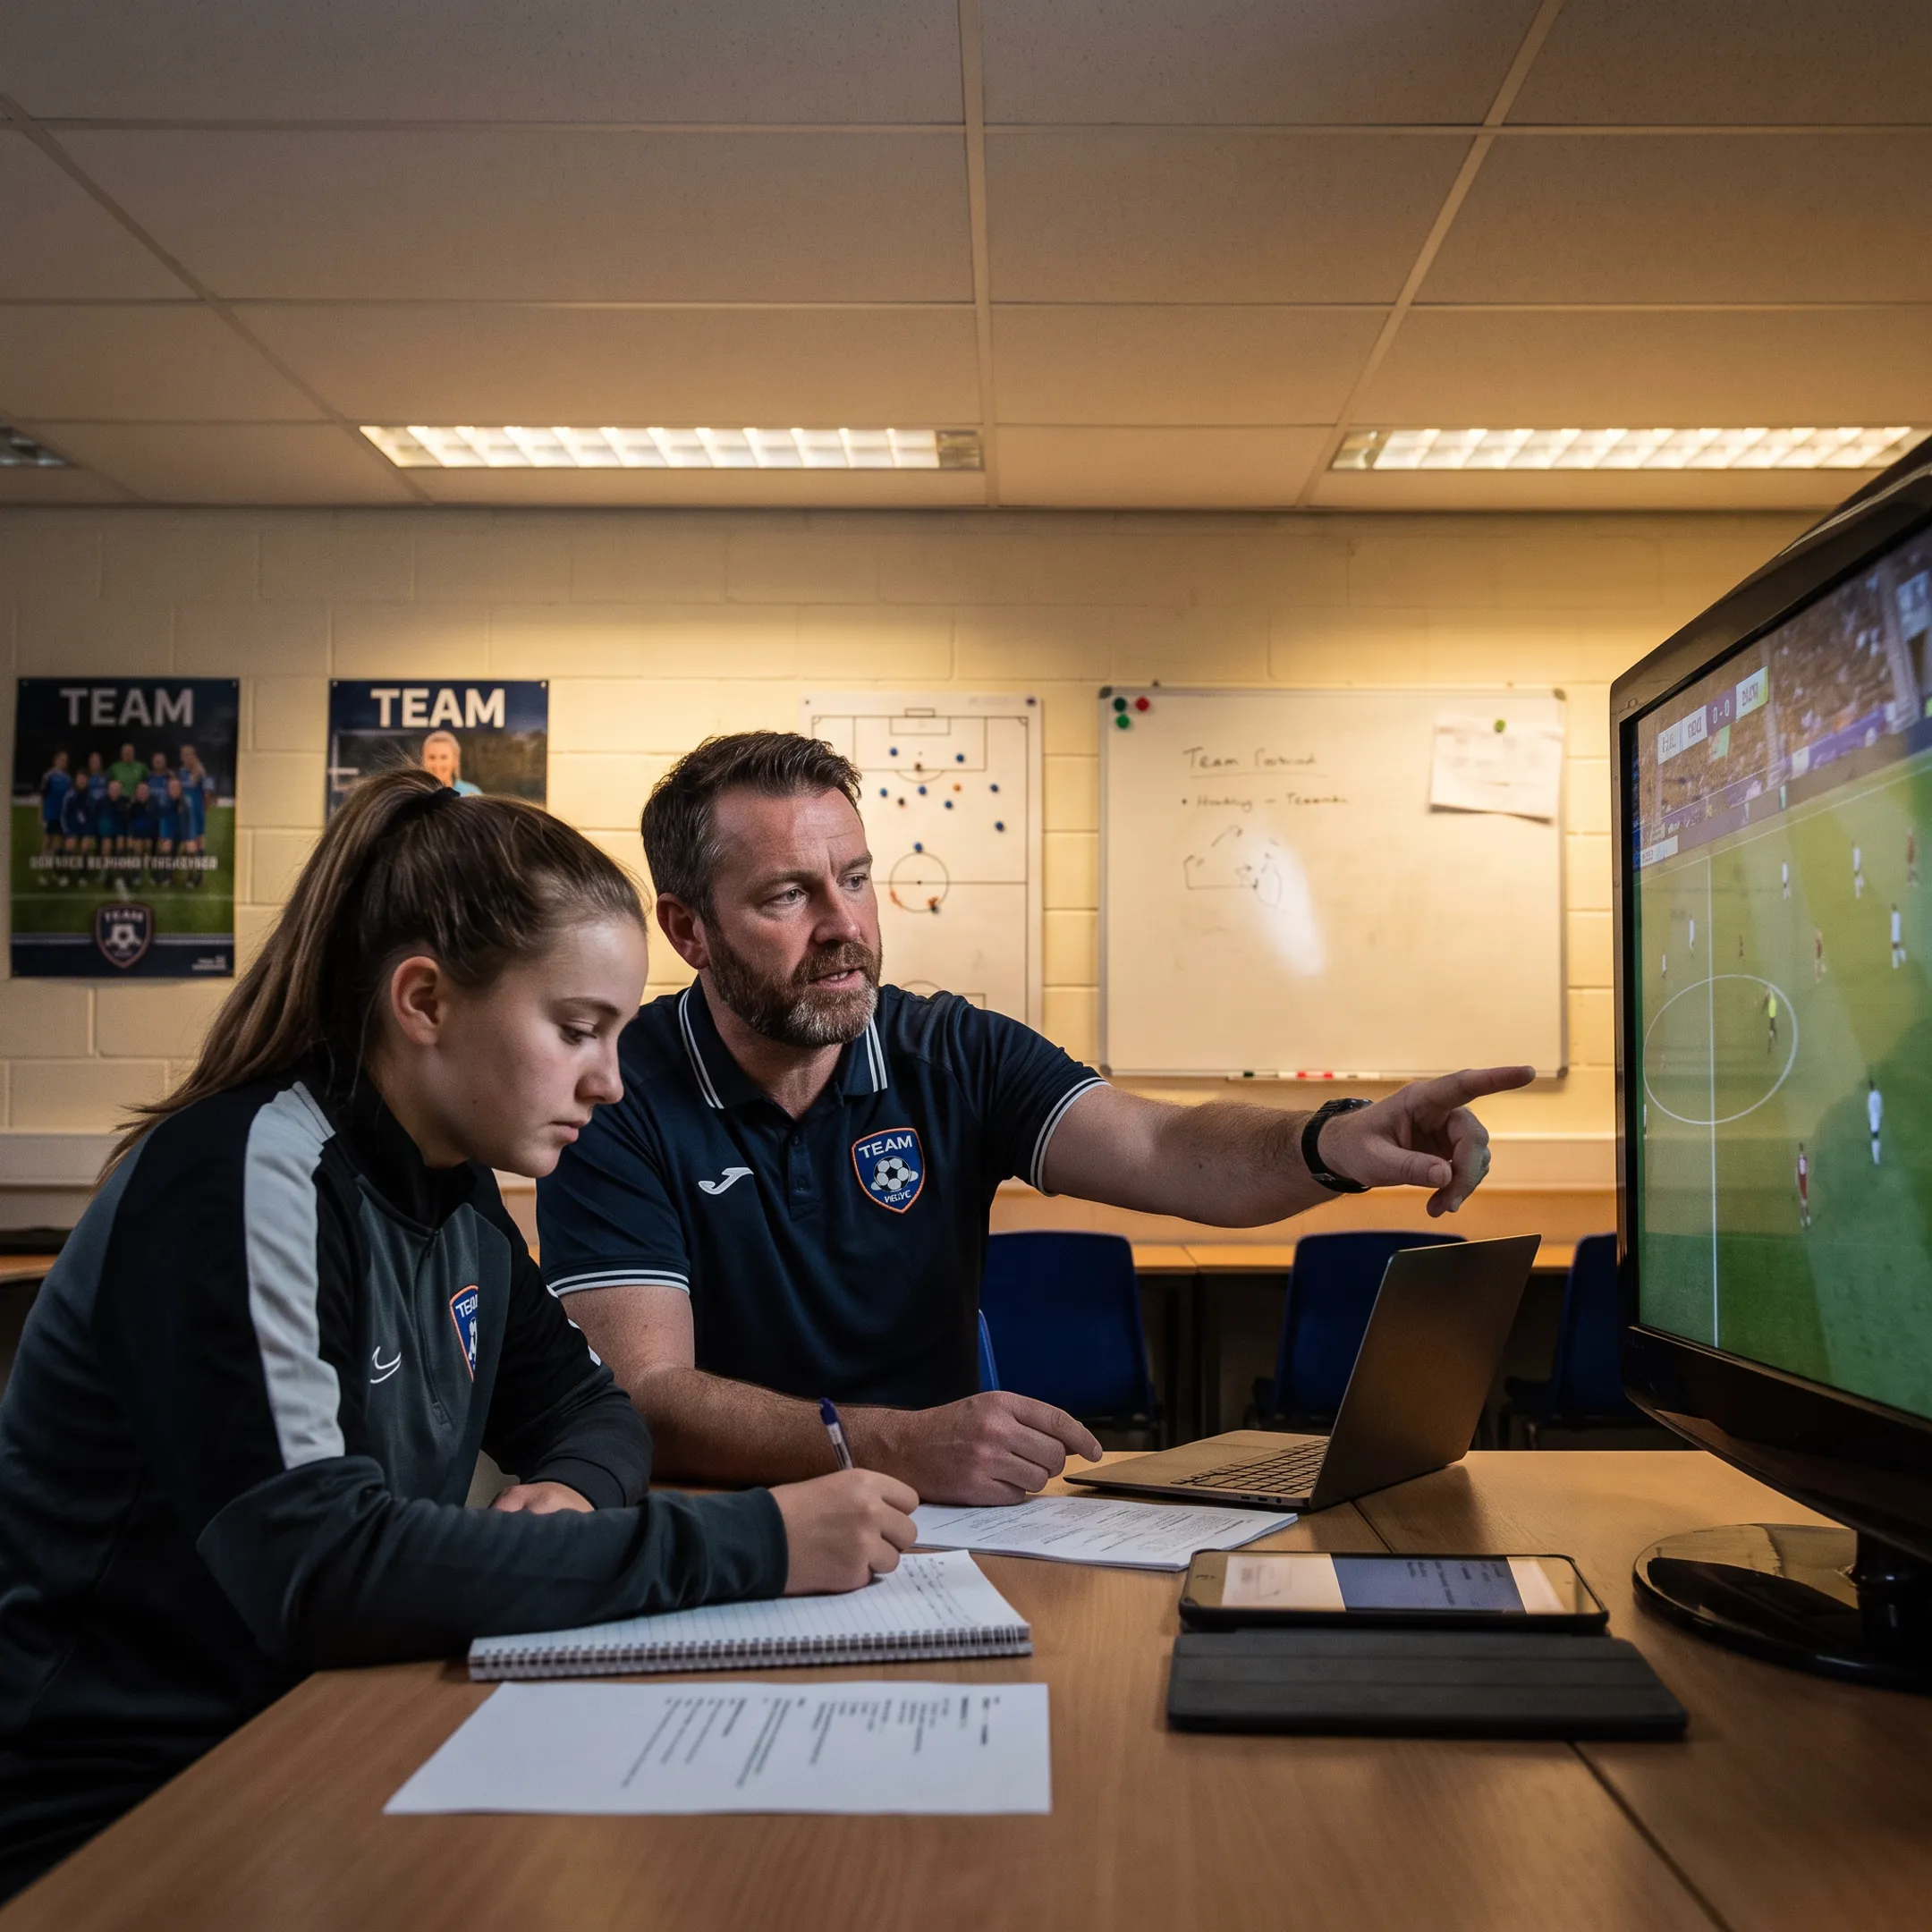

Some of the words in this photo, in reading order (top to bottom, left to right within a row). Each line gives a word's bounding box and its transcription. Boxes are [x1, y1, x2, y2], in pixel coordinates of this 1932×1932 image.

[59, 688, 194, 727] TEAM
[370, 688, 505, 728] TEAM
[859, 1135, 912, 1158] TEAM
